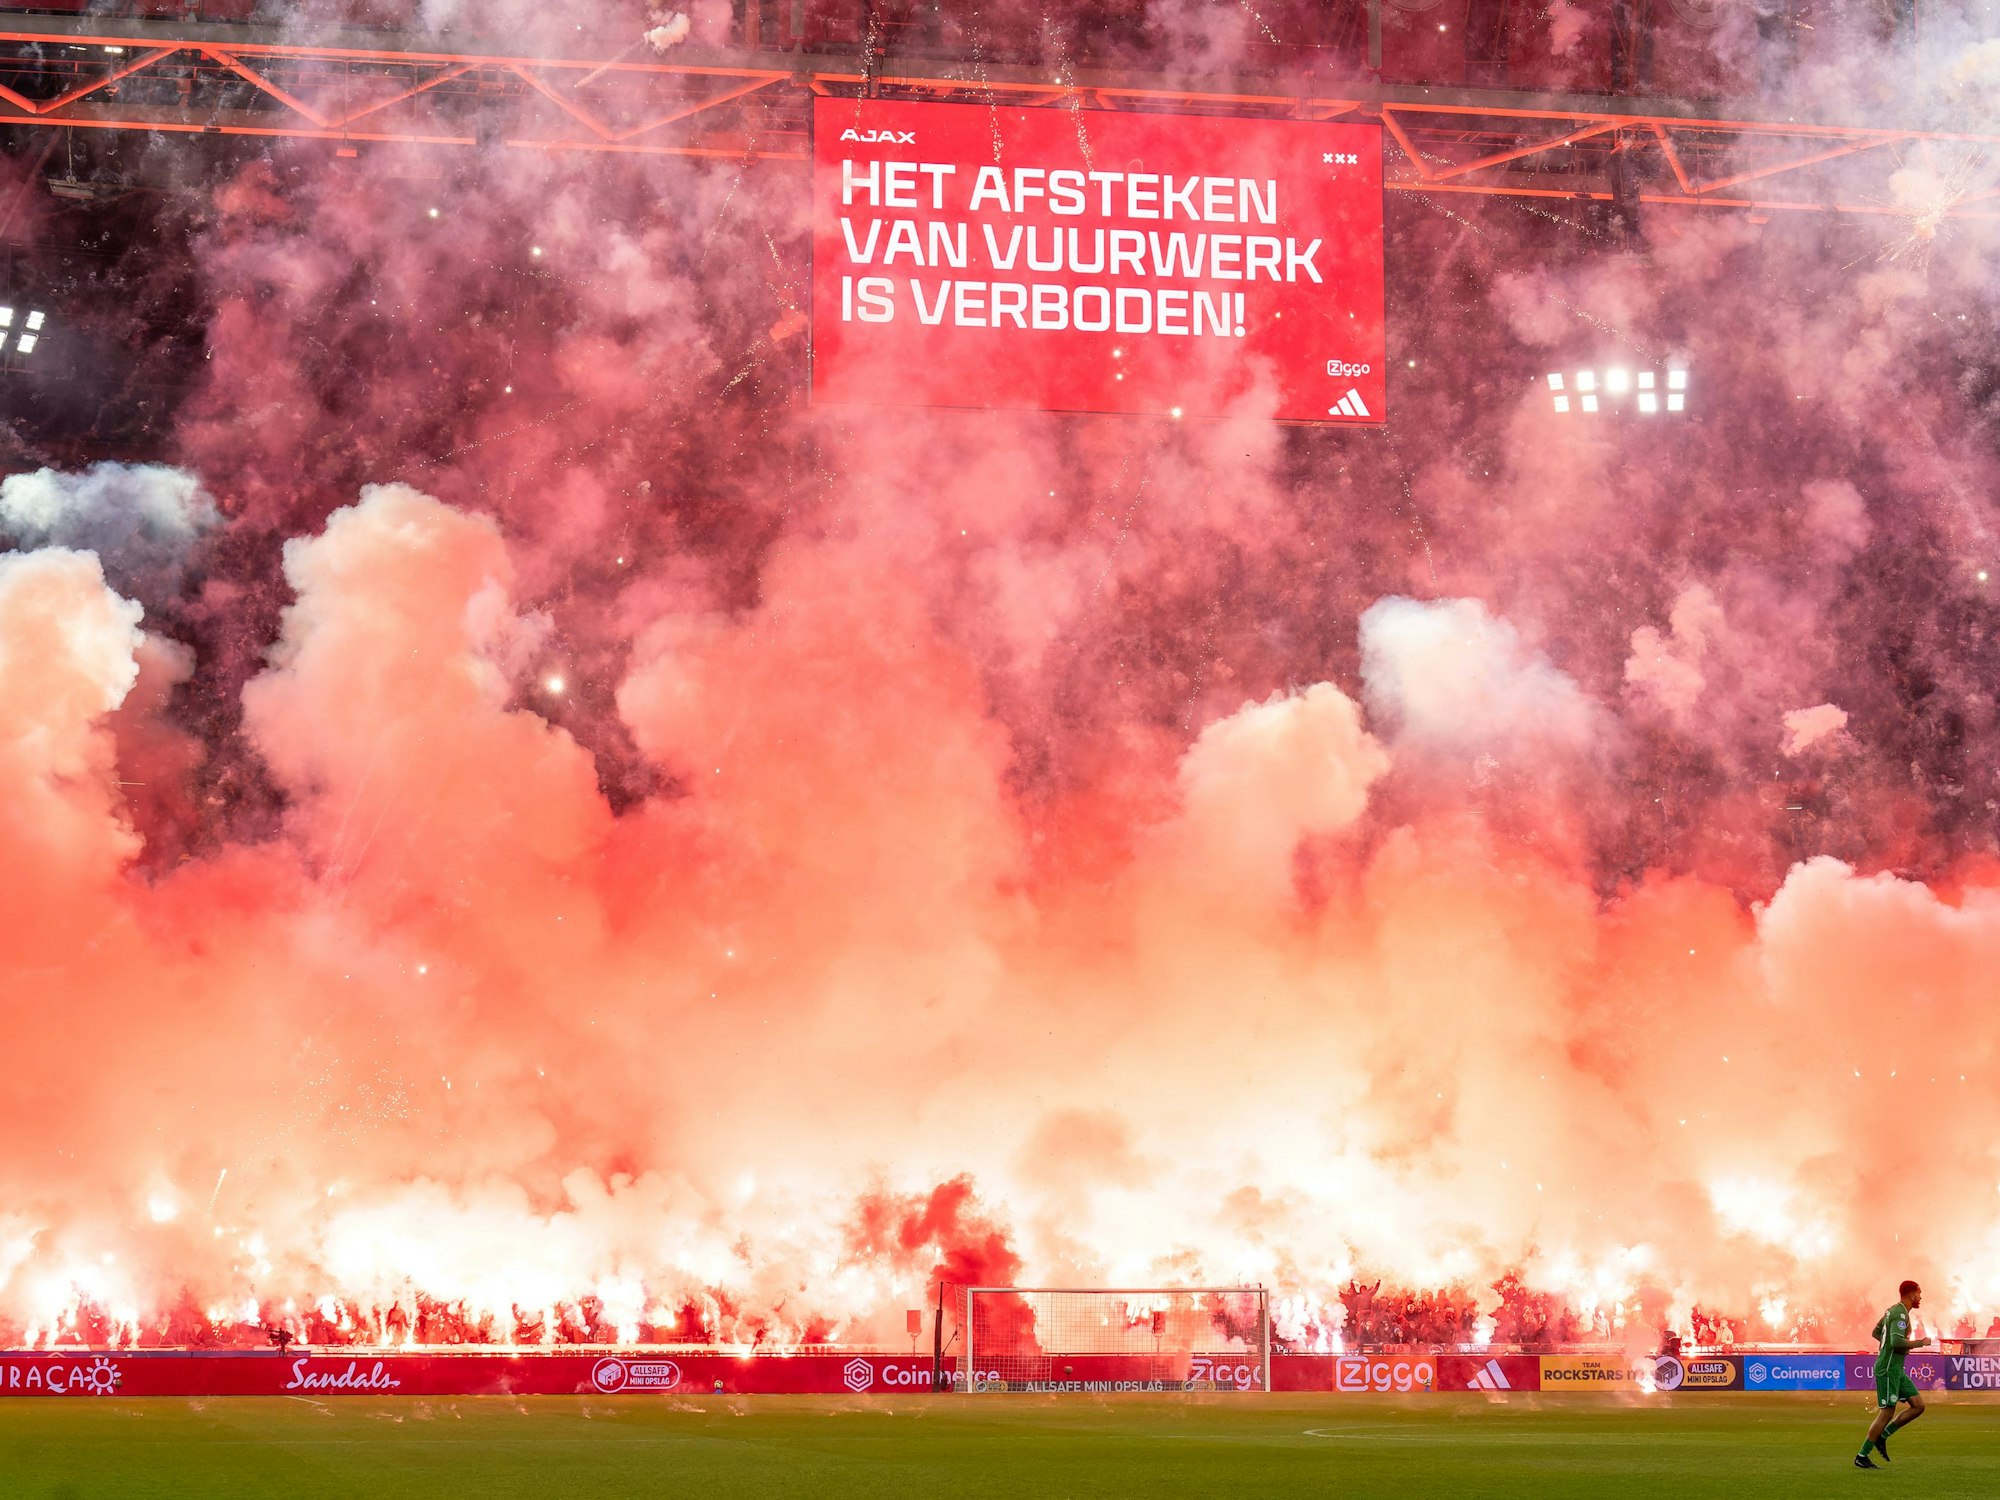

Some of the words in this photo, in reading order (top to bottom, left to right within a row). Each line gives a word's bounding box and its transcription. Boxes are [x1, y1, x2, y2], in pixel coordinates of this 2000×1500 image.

[840, 129, 916, 144] AJAX
[842, 160, 956, 209] HET
[969, 167, 1277, 225] AFSTEKEN
[840, 218, 967, 268] VAN
[982, 224, 1323, 283] VUURWERK
[842, 276, 895, 323] IS
[909, 279, 1245, 338] VERBODEN!
[286, 1358, 400, 1389] Sandals
[634, 1366, 666, 1375] ALLSAFE
[1544, 1369, 1624, 1381] ROCKSTARS
[1691, 1364, 1723, 1373] ALLSAFE
[1771, 1366, 1841, 1380] Coinmerce
[630, 1377, 645, 1385] MINI
[645, 1377, 670, 1385] OPSLAG
[1687, 1375, 1702, 1383] MINI
[1702, 1375, 1728, 1383] OPSLAG
[1025, 1381, 1082, 1392] ALLSAFE
[1084, 1381, 1112, 1392] MINI
[1114, 1380, 1163, 1392] OPSLAG
